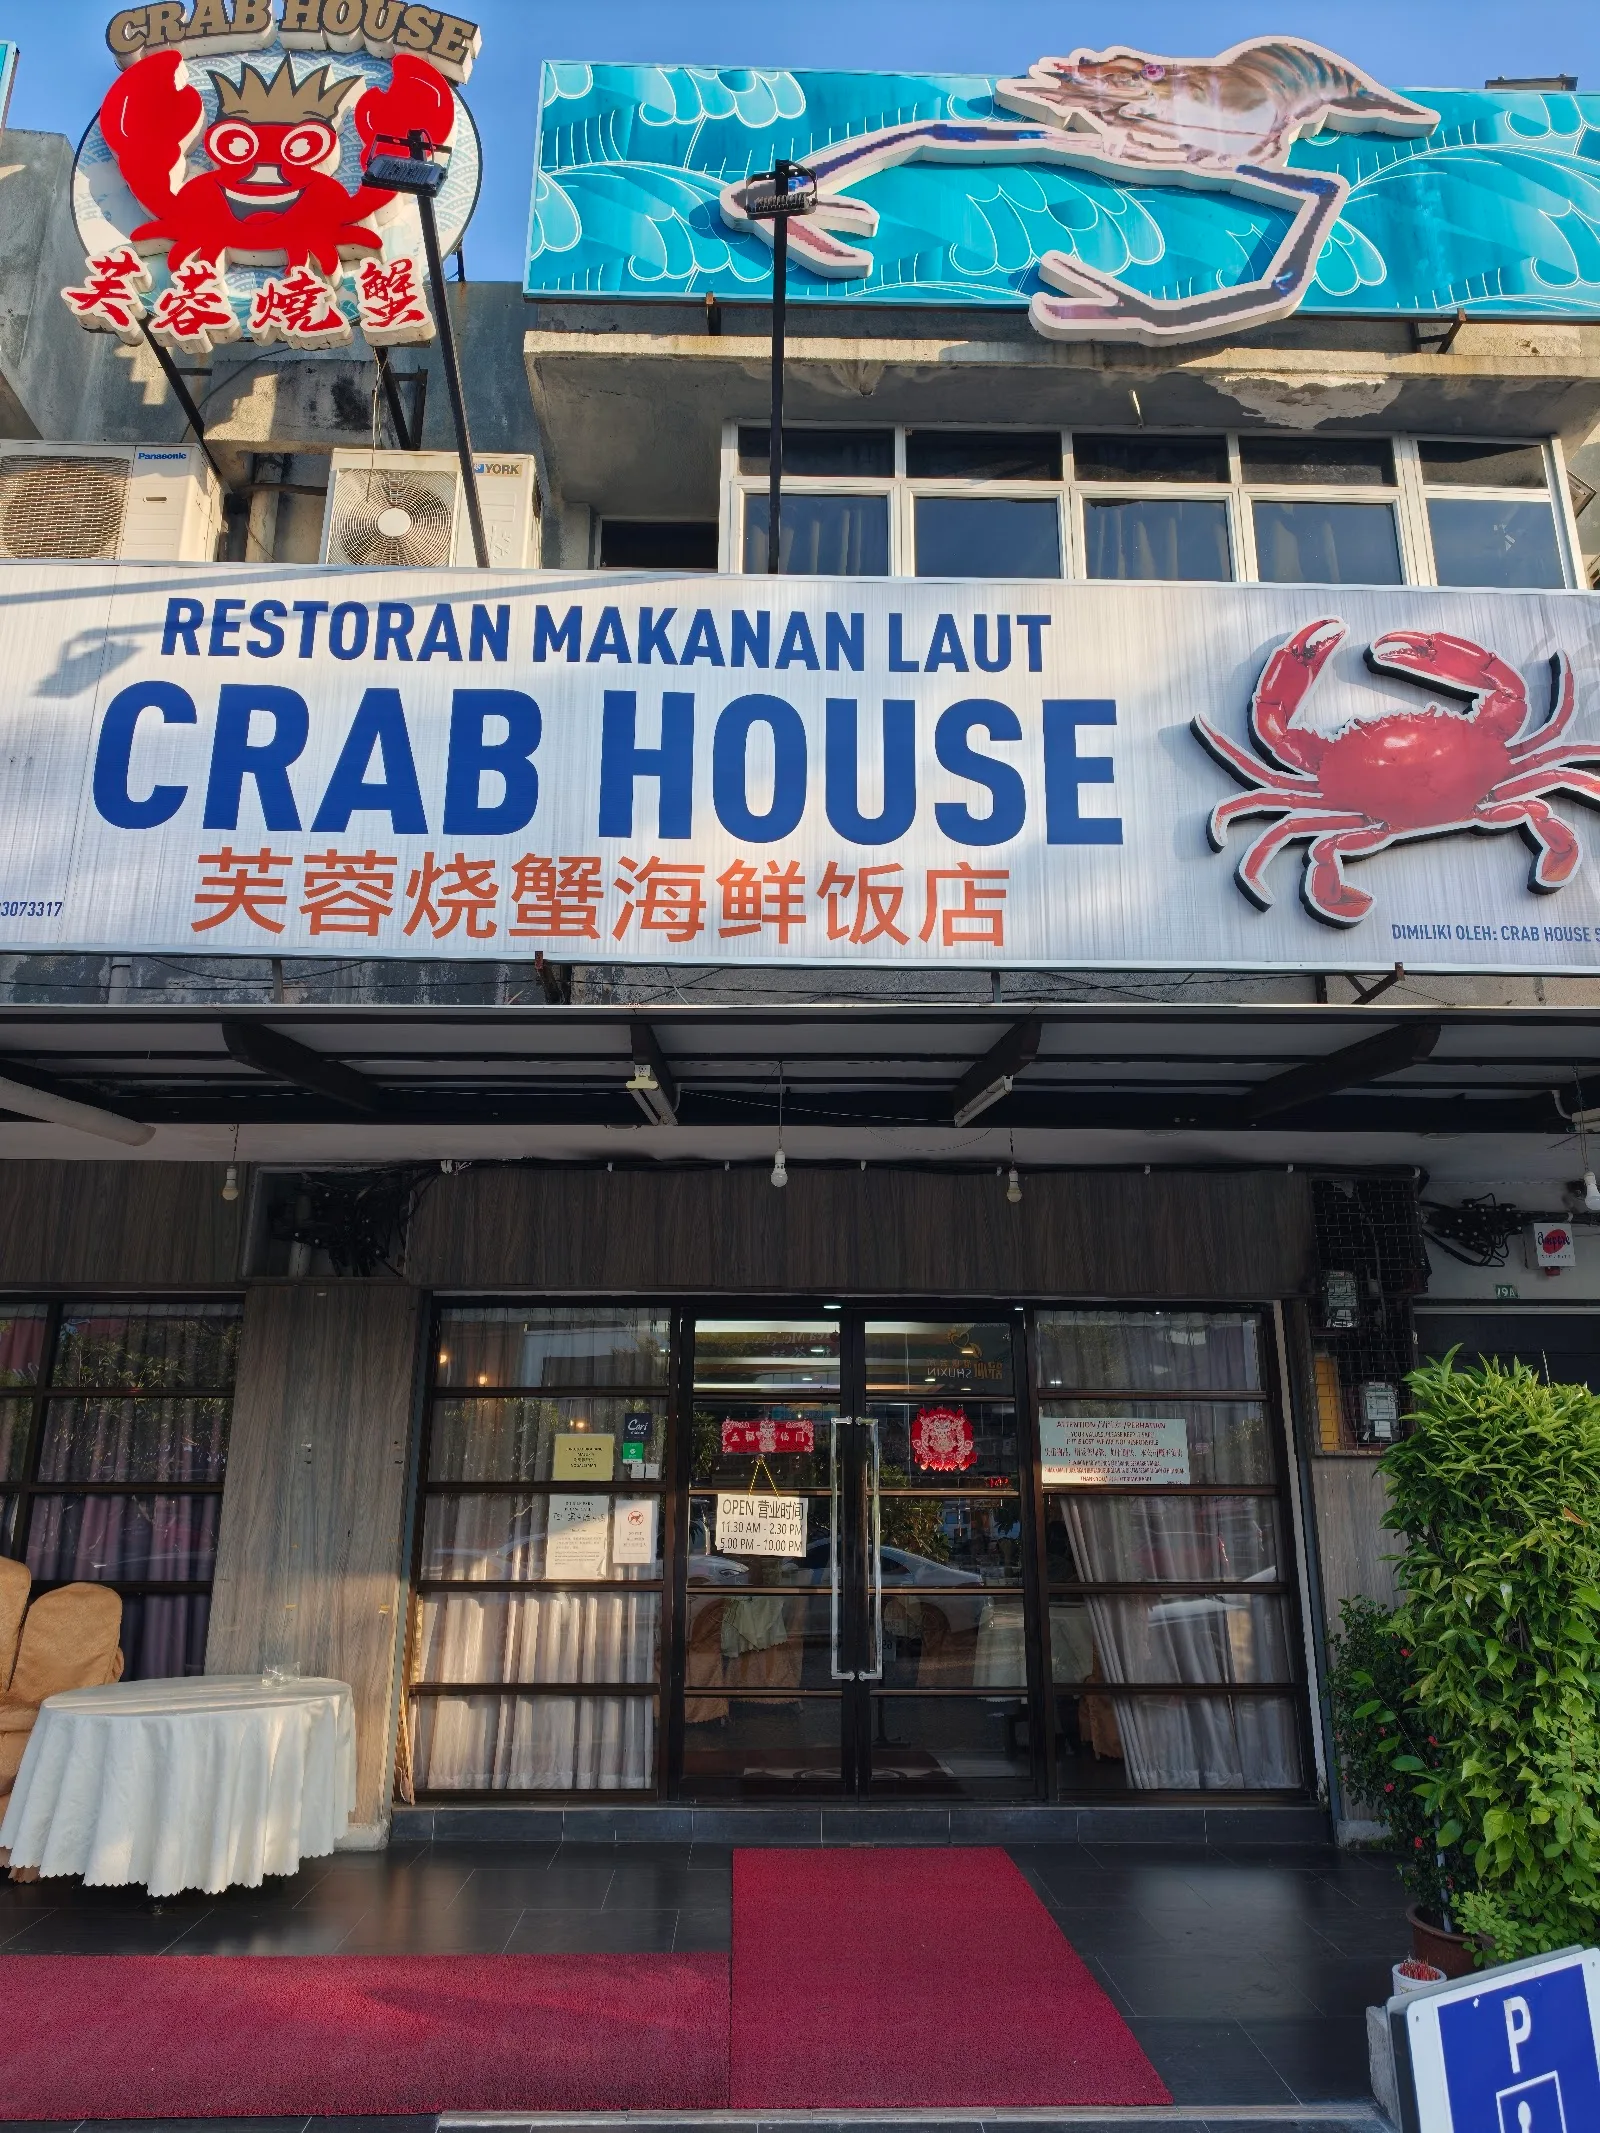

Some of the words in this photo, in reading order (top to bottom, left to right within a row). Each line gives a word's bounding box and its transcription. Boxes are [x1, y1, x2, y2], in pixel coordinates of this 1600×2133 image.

[106, 0, 273, 53] CRAB
[280, 0, 480, 65] HOUSE
[66, 250, 426, 336] 芙蓉燒蟹
[138, 452, 187, 460] Panasonic
[484, 463, 520, 475] YORK
[162, 598, 510, 661] RESTORAN
[532, 605, 865, 672] MAKANAN
[888, 613, 1051, 672] LAUT
[93, 680, 543, 836] CRAB
[598, 690, 1124, 846] HOUSE
[190, 846, 1010, 947] 芙蓉烧蟹海鲜饭店
[1392, 924, 1452, 940] DIMILIKI
[1455, 925, 1498, 941] OLEH:
[1501, 926, 1540, 941] CRAB
[1544, 927, 1592, 942] HOUSE
[721, 1521, 744, 1533] 11.30
[745, 1522, 761, 1534] AM
[769, 1523, 787, 1535] 2.30
[789, 1524, 803, 1536] PM
[722, 1499, 754, 1516] OPEN
[757, 1500, 804, 1520] 营业时间
[720, 1538, 738, 1550] 5.00
[740, 1538, 754, 1551] PM
[763, 1540, 786, 1551] 10.00
[788, 1540, 802, 1553] PM
[1503, 1996, 1532, 2074] P
